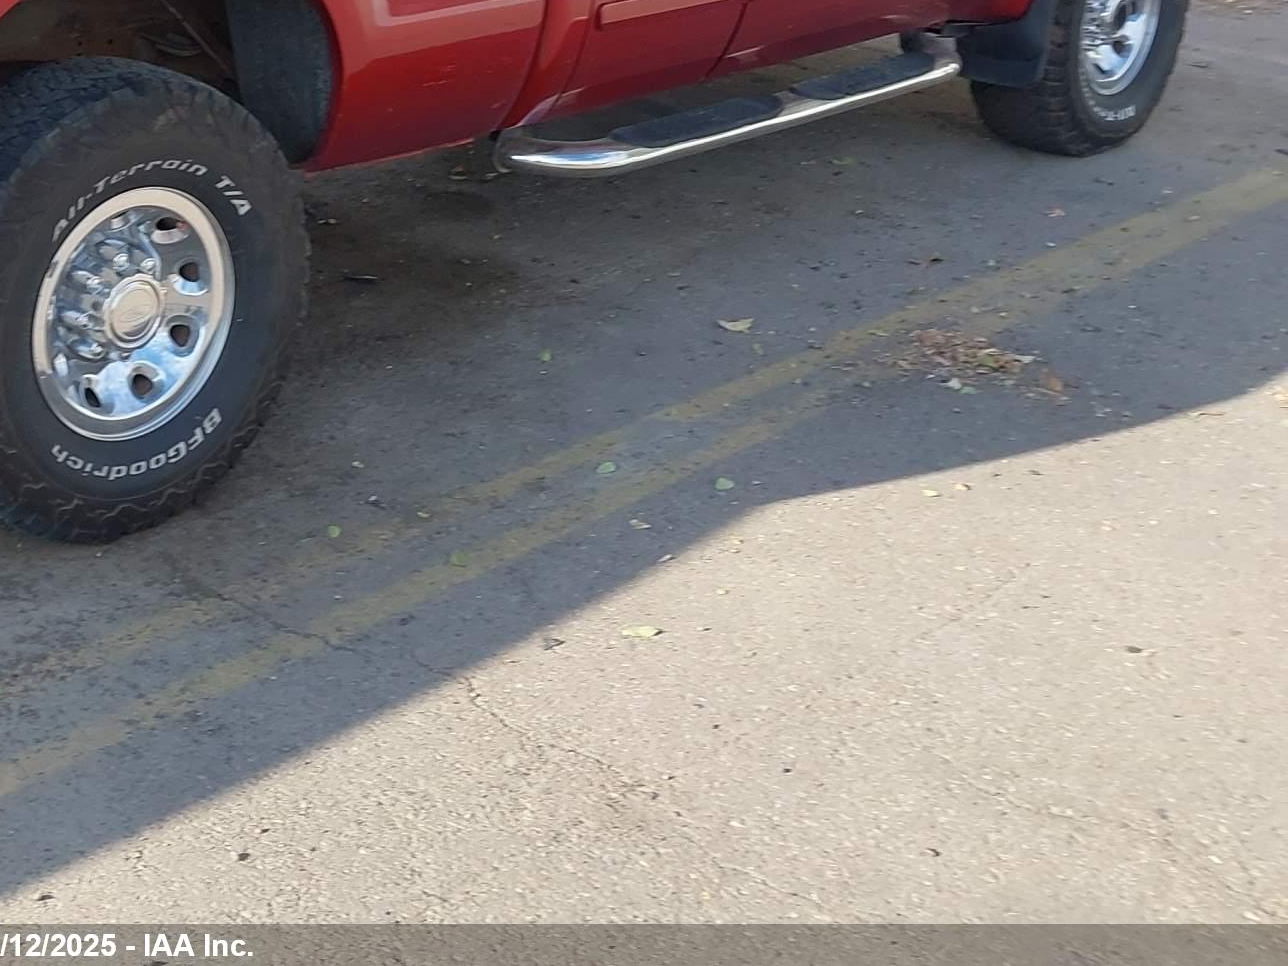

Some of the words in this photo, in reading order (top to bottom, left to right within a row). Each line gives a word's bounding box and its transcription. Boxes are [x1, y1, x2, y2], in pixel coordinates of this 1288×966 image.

[51, 158, 208, 242] All-Terrain
[214, 174, 253, 216] T/A
[50, 407, 223, 481] BFGoodrich
